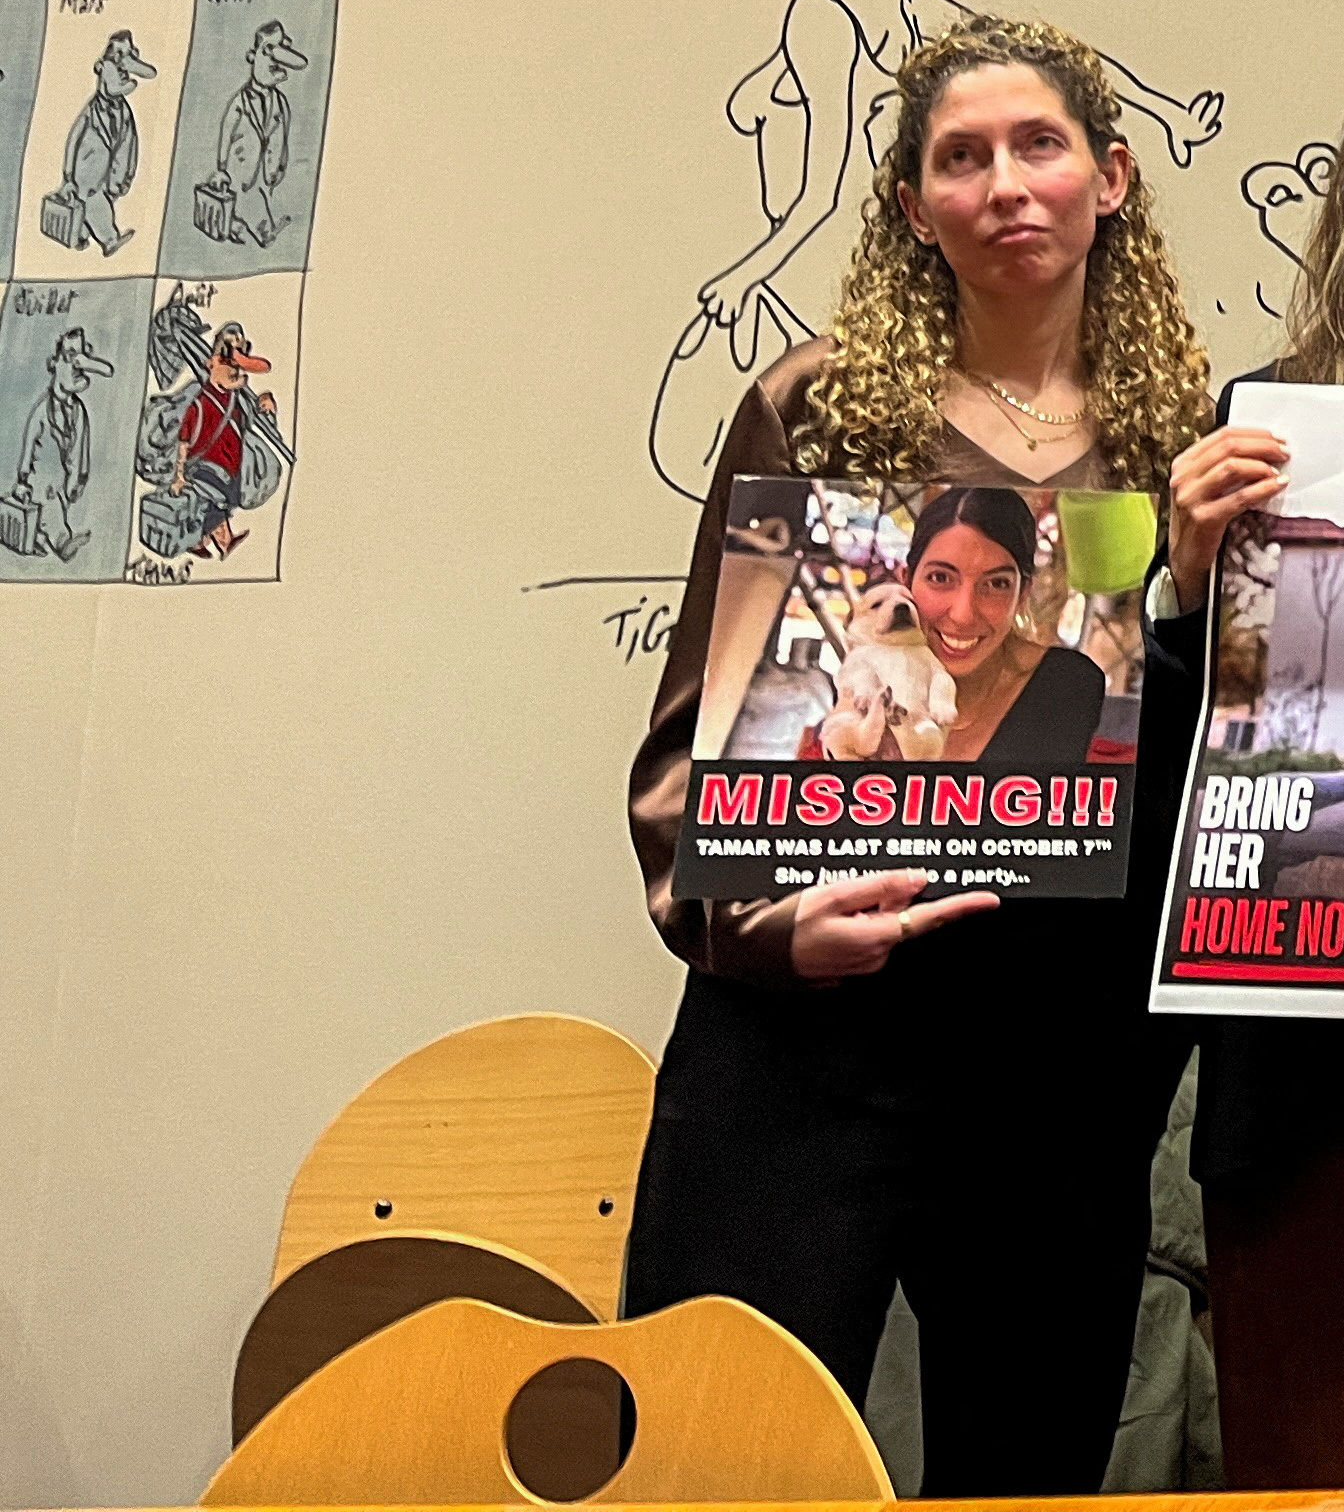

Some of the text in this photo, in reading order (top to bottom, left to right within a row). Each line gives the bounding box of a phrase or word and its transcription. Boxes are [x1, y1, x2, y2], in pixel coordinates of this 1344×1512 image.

[697, 774, 1118, 827] MISSING!!!
[1198, 775, 1315, 831] BRING
[697, 838, 770, 858] TAMAR
[775, 838, 823, 858] WAS
[828, 838, 882, 858] LAST
[886, 838, 942, 858] SEEN
[947, 838, 976, 858] ON
[982, 838, 1079, 858] OCTOBER
[1189, 833, 1266, 889] HER
[944, 869, 957, 884] a
[1180, 897, 1289, 956] HOME
